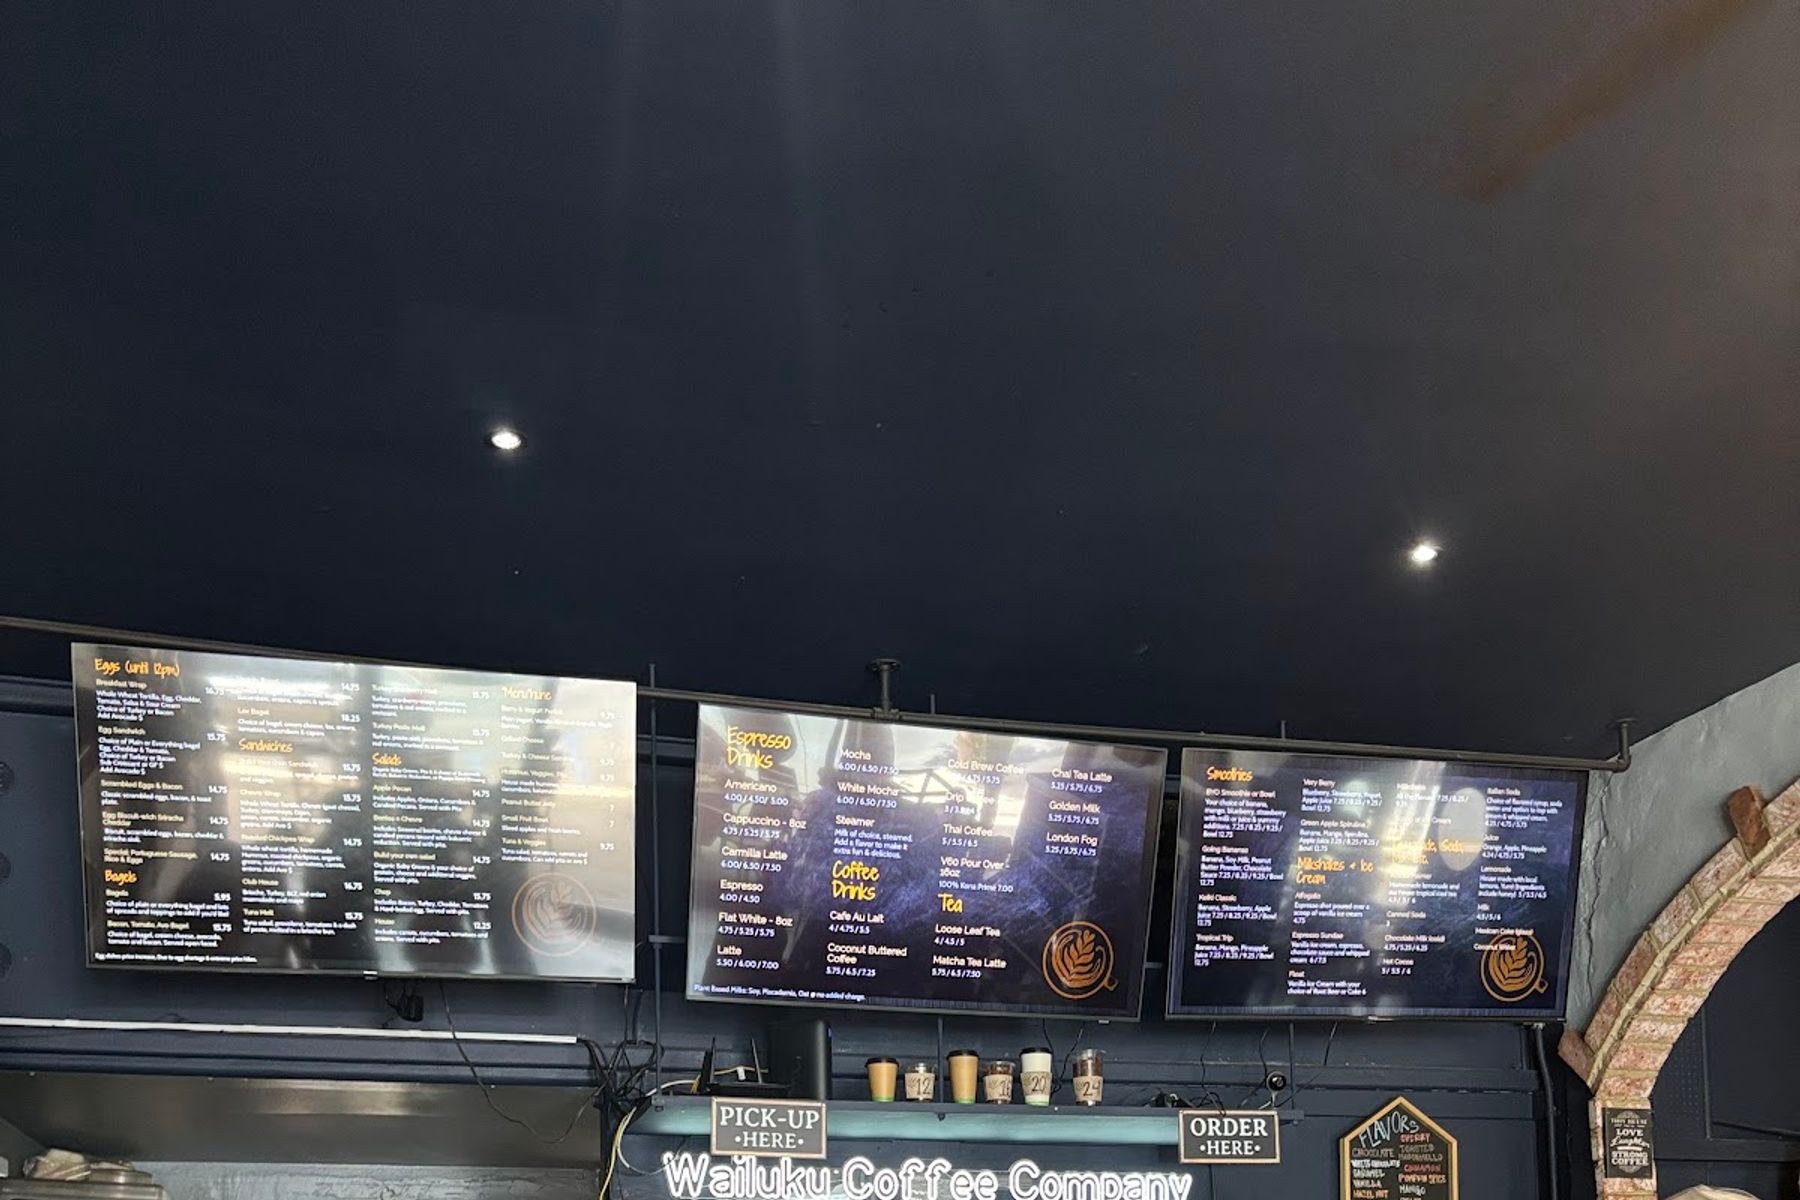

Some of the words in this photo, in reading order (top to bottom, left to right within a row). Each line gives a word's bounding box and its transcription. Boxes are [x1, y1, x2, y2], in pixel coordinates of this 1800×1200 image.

[95, 659, 120, 675] Eggs
[96, 679, 127, 687] Breakfast
[128, 681, 147, 689] Wrap
[98, 726, 112, 735] Egg
[112, 726, 146, 735] Sandwich
[239, 738, 293, 753] Sandwiches
[727, 725, 791, 752] Espresso
[372, 752, 402, 766] Salads
[726, 746, 773, 768] Drinks
[840, 749, 871, 760] Mocha
[948, 759, 969, 770] Cold
[970, 760, 994, 771] Brew
[995, 763, 1025, 774] Coffee
[1206, 766, 1254, 781] Smoothies
[1051, 768, 1072, 779] Chai
[1073, 770, 1089, 780] Tea
[1090, 772, 1112, 782] Latte
[100, 779, 137, 788] Scrambled
[138, 781, 154, 790] Eggs
[162, 782, 183, 790] Bacon
[724, 778, 777, 792] Americano
[837, 781, 865, 794] White
[867, 785, 900, 796] Mocha
[1049, 800, 1081, 811] Golden
[1082, 802, 1100, 813] Milk
[723, 813, 781, 827] Cappuccino
[789, 818, 807, 829] 8oz
[835, 815, 875, 827] Steamer
[834, 829, 849, 837] Milk
[943, 824, 962, 834] Thai
[964, 826, 992, 836] Coffee
[1046, 832, 1080, 844] London
[1081, 834, 1098, 847] Fog
[763, 849, 788, 861] Latte
[960, 857, 981, 868] Pour
[982, 859, 1004, 870] Over
[1297, 857, 1345, 871] Milkshakes
[105, 869, 137, 885] Bagels
[832, 860, 880, 882] Coffee
[1296, 871, 1326, 884] Cream
[242, 878, 258, 886] Club
[258, 879, 279, 887] House
[720, 879, 764, 891] Espresso
[831, 879, 876, 900] Drinks
[105, 889, 129, 897] Bagels
[214, 893, 231, 901] 5.95
[937, 893, 963, 913] Tea
[242, 908, 259, 916] Tuna
[718, 911, 737, 922] Flat
[739, 913, 767, 925] White
[775, 916, 793, 927] 8oz
[830, 910, 851, 921] Cafe
[852, 912, 865, 922] Au
[867, 913, 884, 923] Lait
[935, 923, 962, 935] Loose
[964, 925, 984, 936] Leaf
[985, 927, 1000, 937] Tea
[717, 945, 742, 956] Latte
[827, 942, 867, 954] Coconut
[868, 945, 908, 956] Buttered
[826, 953, 857, 964] Coffee
[933, 955, 966, 966] Matcha
[966, 956, 982, 967] Tea
[984, 958, 1007, 968] Latte
[915, 1077, 931, 1096] 12
[1031, 1075, 1046, 1093] 20
[720, 1107, 820, 1129] PICK-UP
[1191, 1118, 1268, 1137] ORDER
[1358, 1111, 1420, 1149] FLAVORS
[742, 1132, 796, 1149] HERE
[1207, 1140, 1254, 1156] HERE
[1611, 1158, 1649, 1166] COFFEE
[663, 1152, 831, 1200] Wailuku
[1400, 1185, 1426, 1195] MANGO
